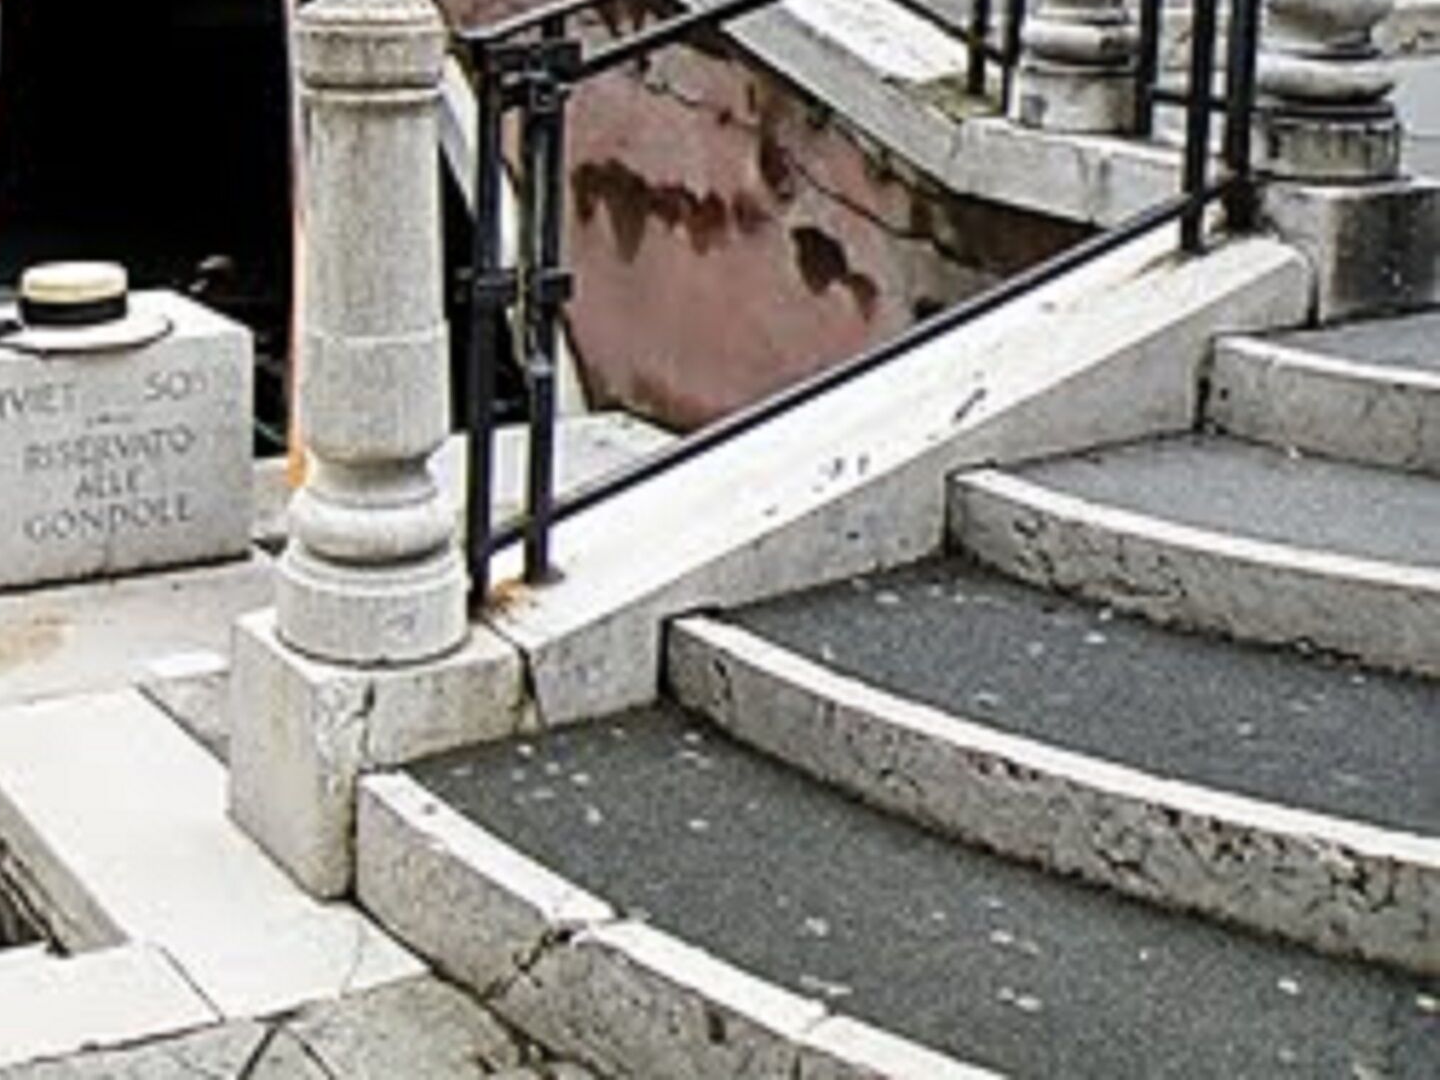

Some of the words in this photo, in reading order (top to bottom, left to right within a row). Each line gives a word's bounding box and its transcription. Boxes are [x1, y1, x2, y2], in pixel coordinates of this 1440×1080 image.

[23, 423, 197, 471] RISERVATO
[74, 464, 143, 500] ALLE
[23, 492, 195, 542] GONDOLE
